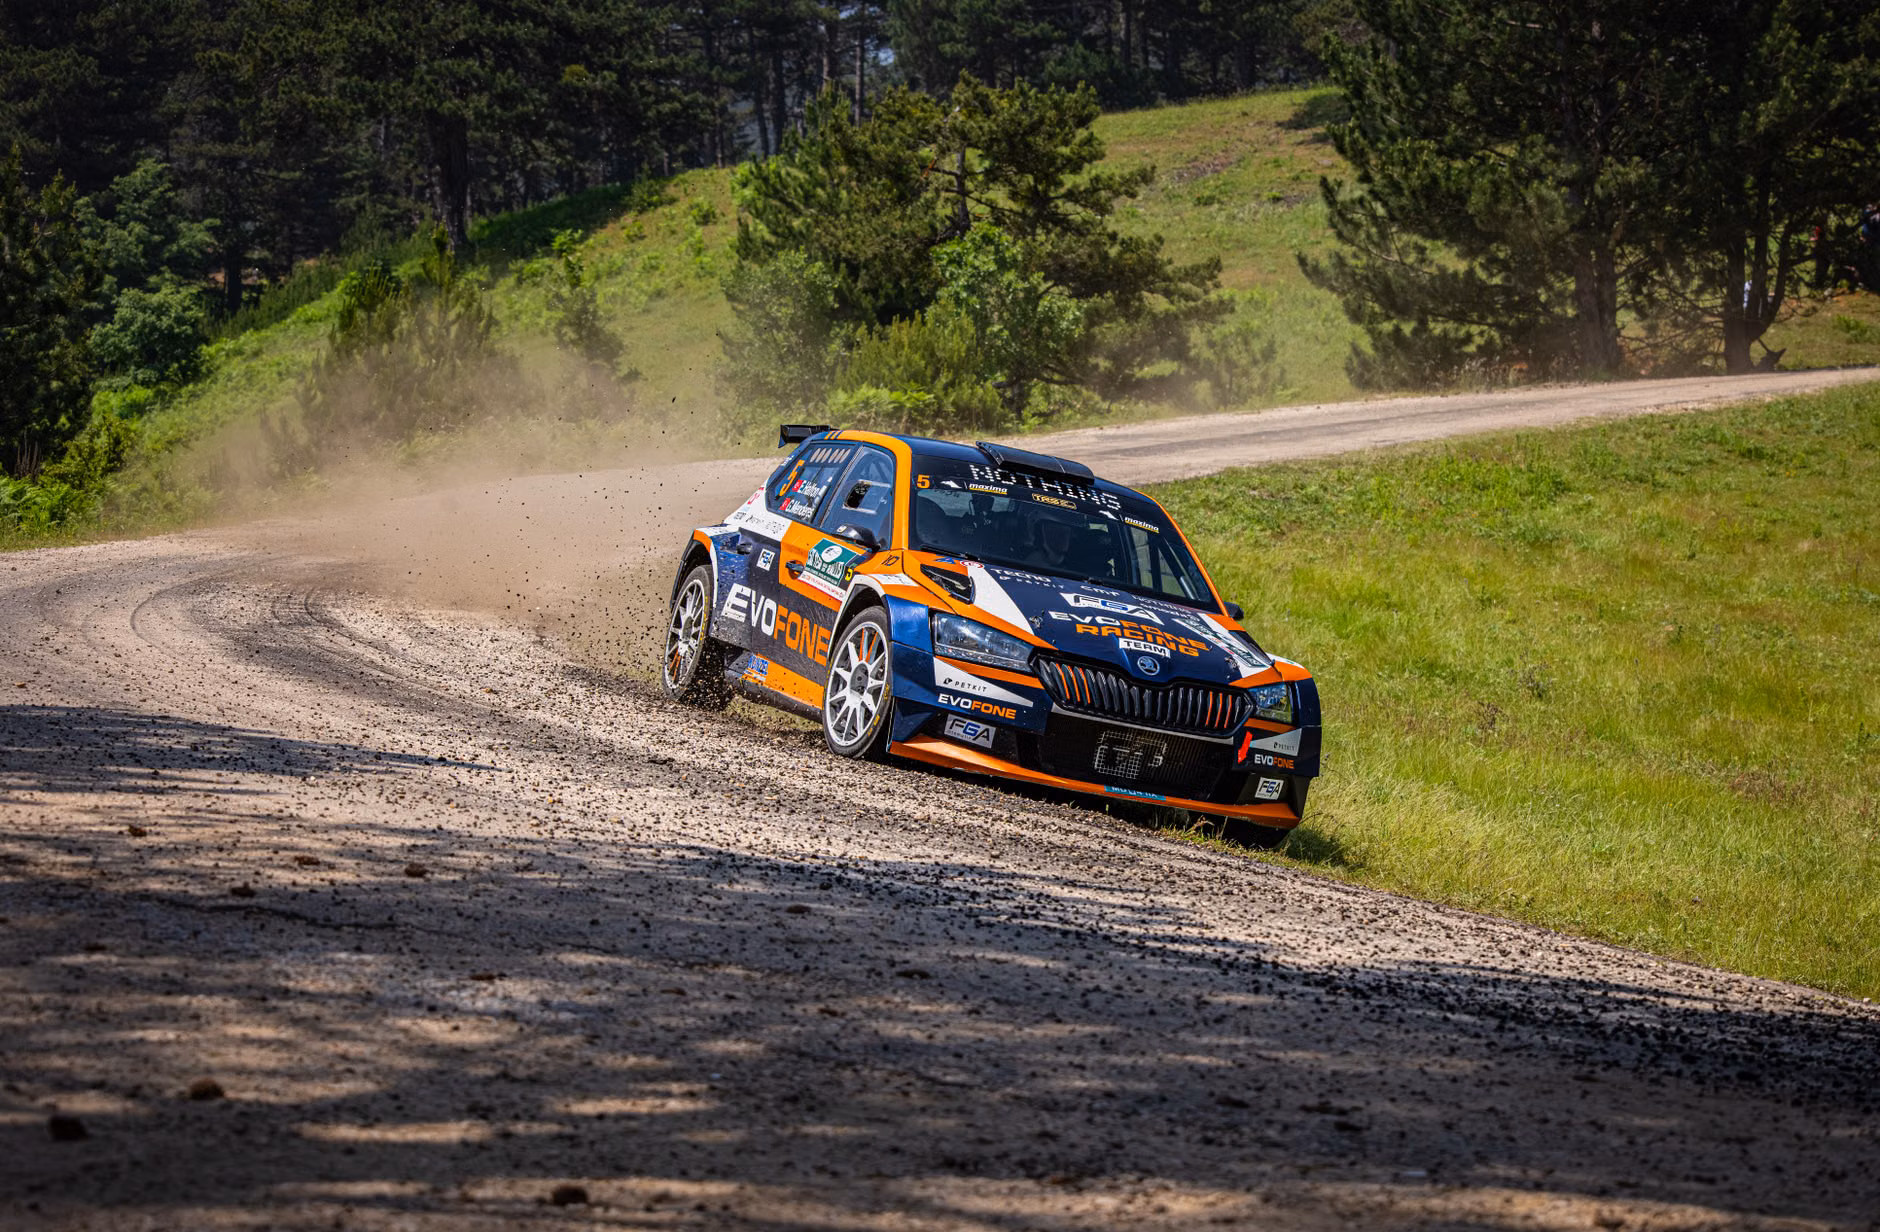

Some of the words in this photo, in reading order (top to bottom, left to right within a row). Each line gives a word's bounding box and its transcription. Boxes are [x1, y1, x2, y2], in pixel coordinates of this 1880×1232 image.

[916, 474, 931, 489] 5
[969, 483, 1008, 494] maxima
[1124, 516, 1160, 531] maxima
[721, 583, 832, 667] EVOFONE
[1049, 610, 1210, 651] EVOFONE
[1076, 623, 1200, 657] RACING
[1124, 640, 1166, 655] TEAM
[954, 681, 988, 693] PETKIT
[938, 693, 1017, 719] EVOFONE
[1254, 753, 1295, 769] EVOFONE
